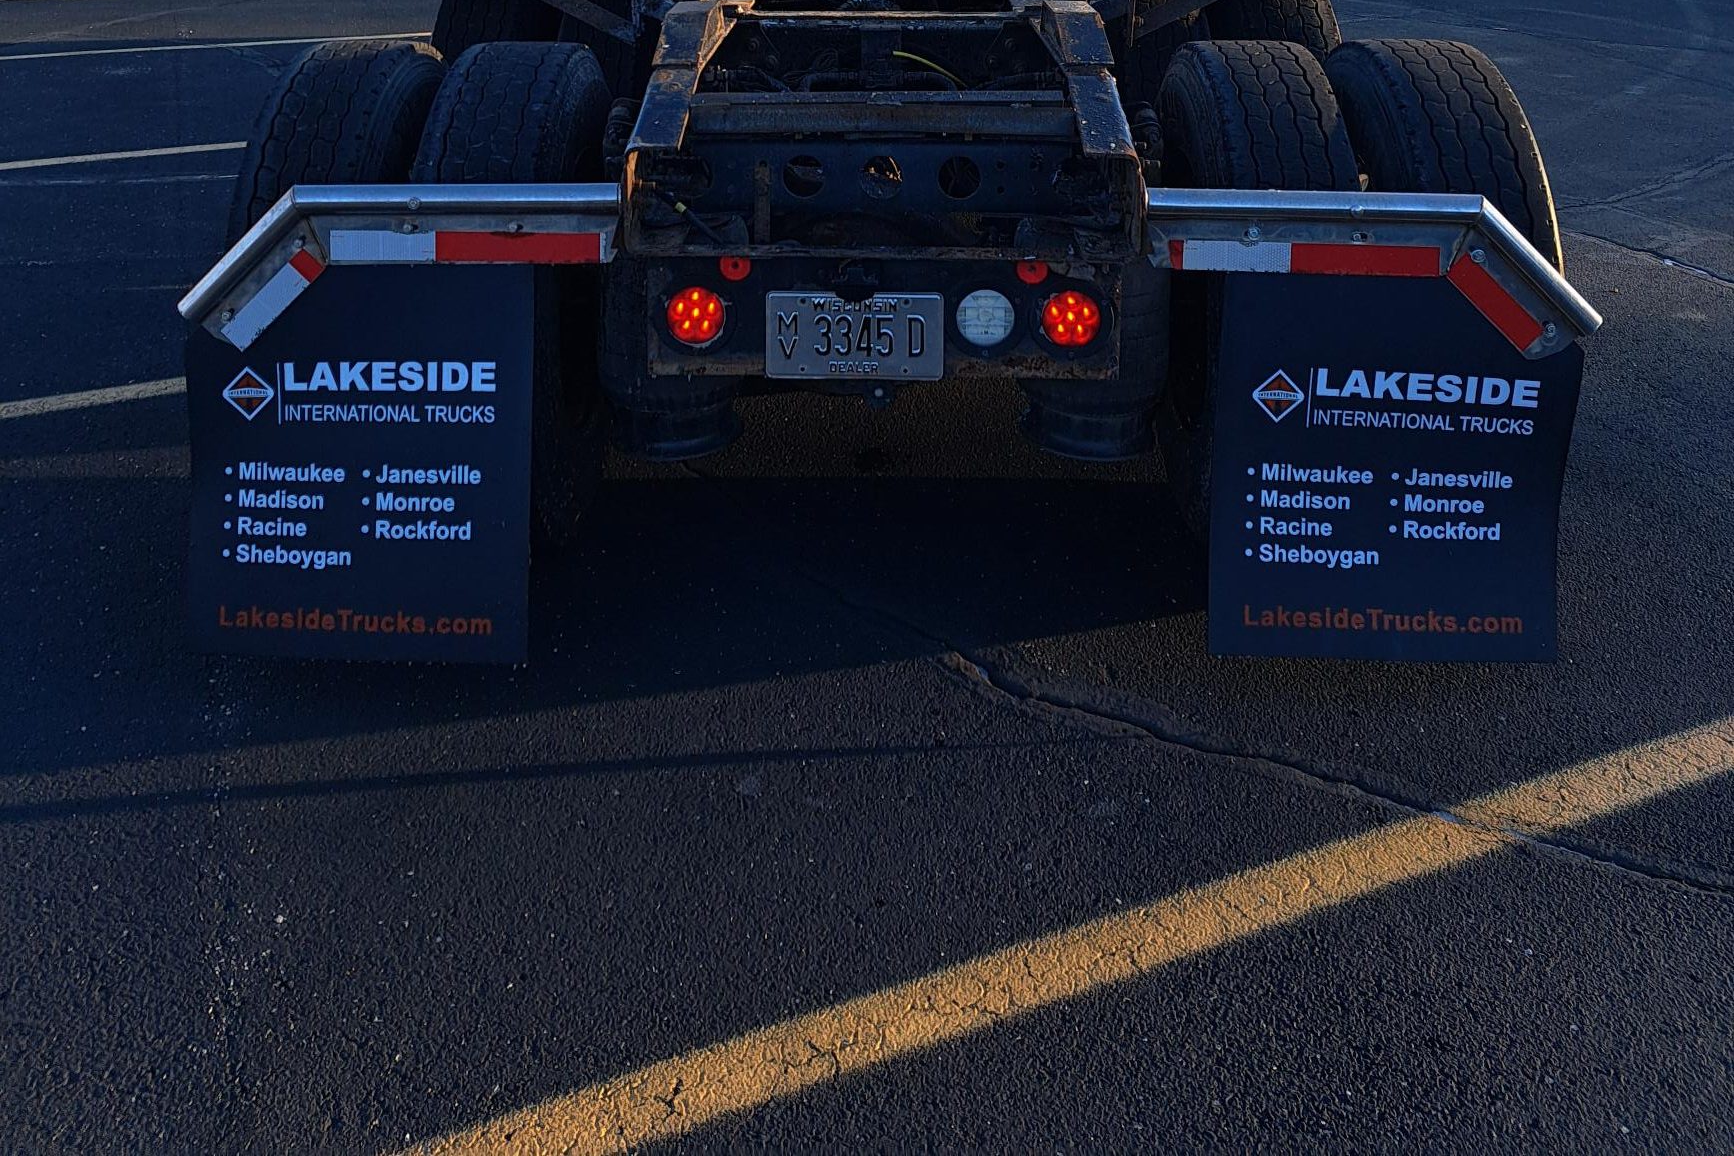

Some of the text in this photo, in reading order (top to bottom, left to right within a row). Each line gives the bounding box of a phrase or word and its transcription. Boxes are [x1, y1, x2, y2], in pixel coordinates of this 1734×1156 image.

[814, 314, 926, 357] 3345 D
[284, 362, 496, 391] LAKESIDE
[828, 361, 879, 373] DEALER
[1315, 368, 1540, 408] LAKESIDE
[285, 404, 495, 423] INTERNATIONAL TRUCKS
[1314, 409, 1534, 435] INTERNATIONAL TRUCKS
[239, 462, 345, 482] Milwaukee
[376, 465, 481, 484] Janesville
[1262, 463, 1373, 484] Milwaukee
[1405, 468, 1512, 488] Janesville
[239, 489, 323, 509] Madison
[376, 493, 454, 512] Monroe
[1261, 490, 1350, 509] Madison
[1405, 494, 1484, 513] Monroe
[238, 517, 306, 536] Racine
[376, 520, 471, 540] Rockford
[1261, 517, 1332, 536] Racine
[1404, 521, 1500, 540] Rockford
[236, 544, 351, 569] Sheboygan
[1259, 544, 1378, 568] Sheboygan
[218, 606, 492, 635] LakesideTrucks.com
[1243, 604, 1523, 634] LakesideTrucks.com
